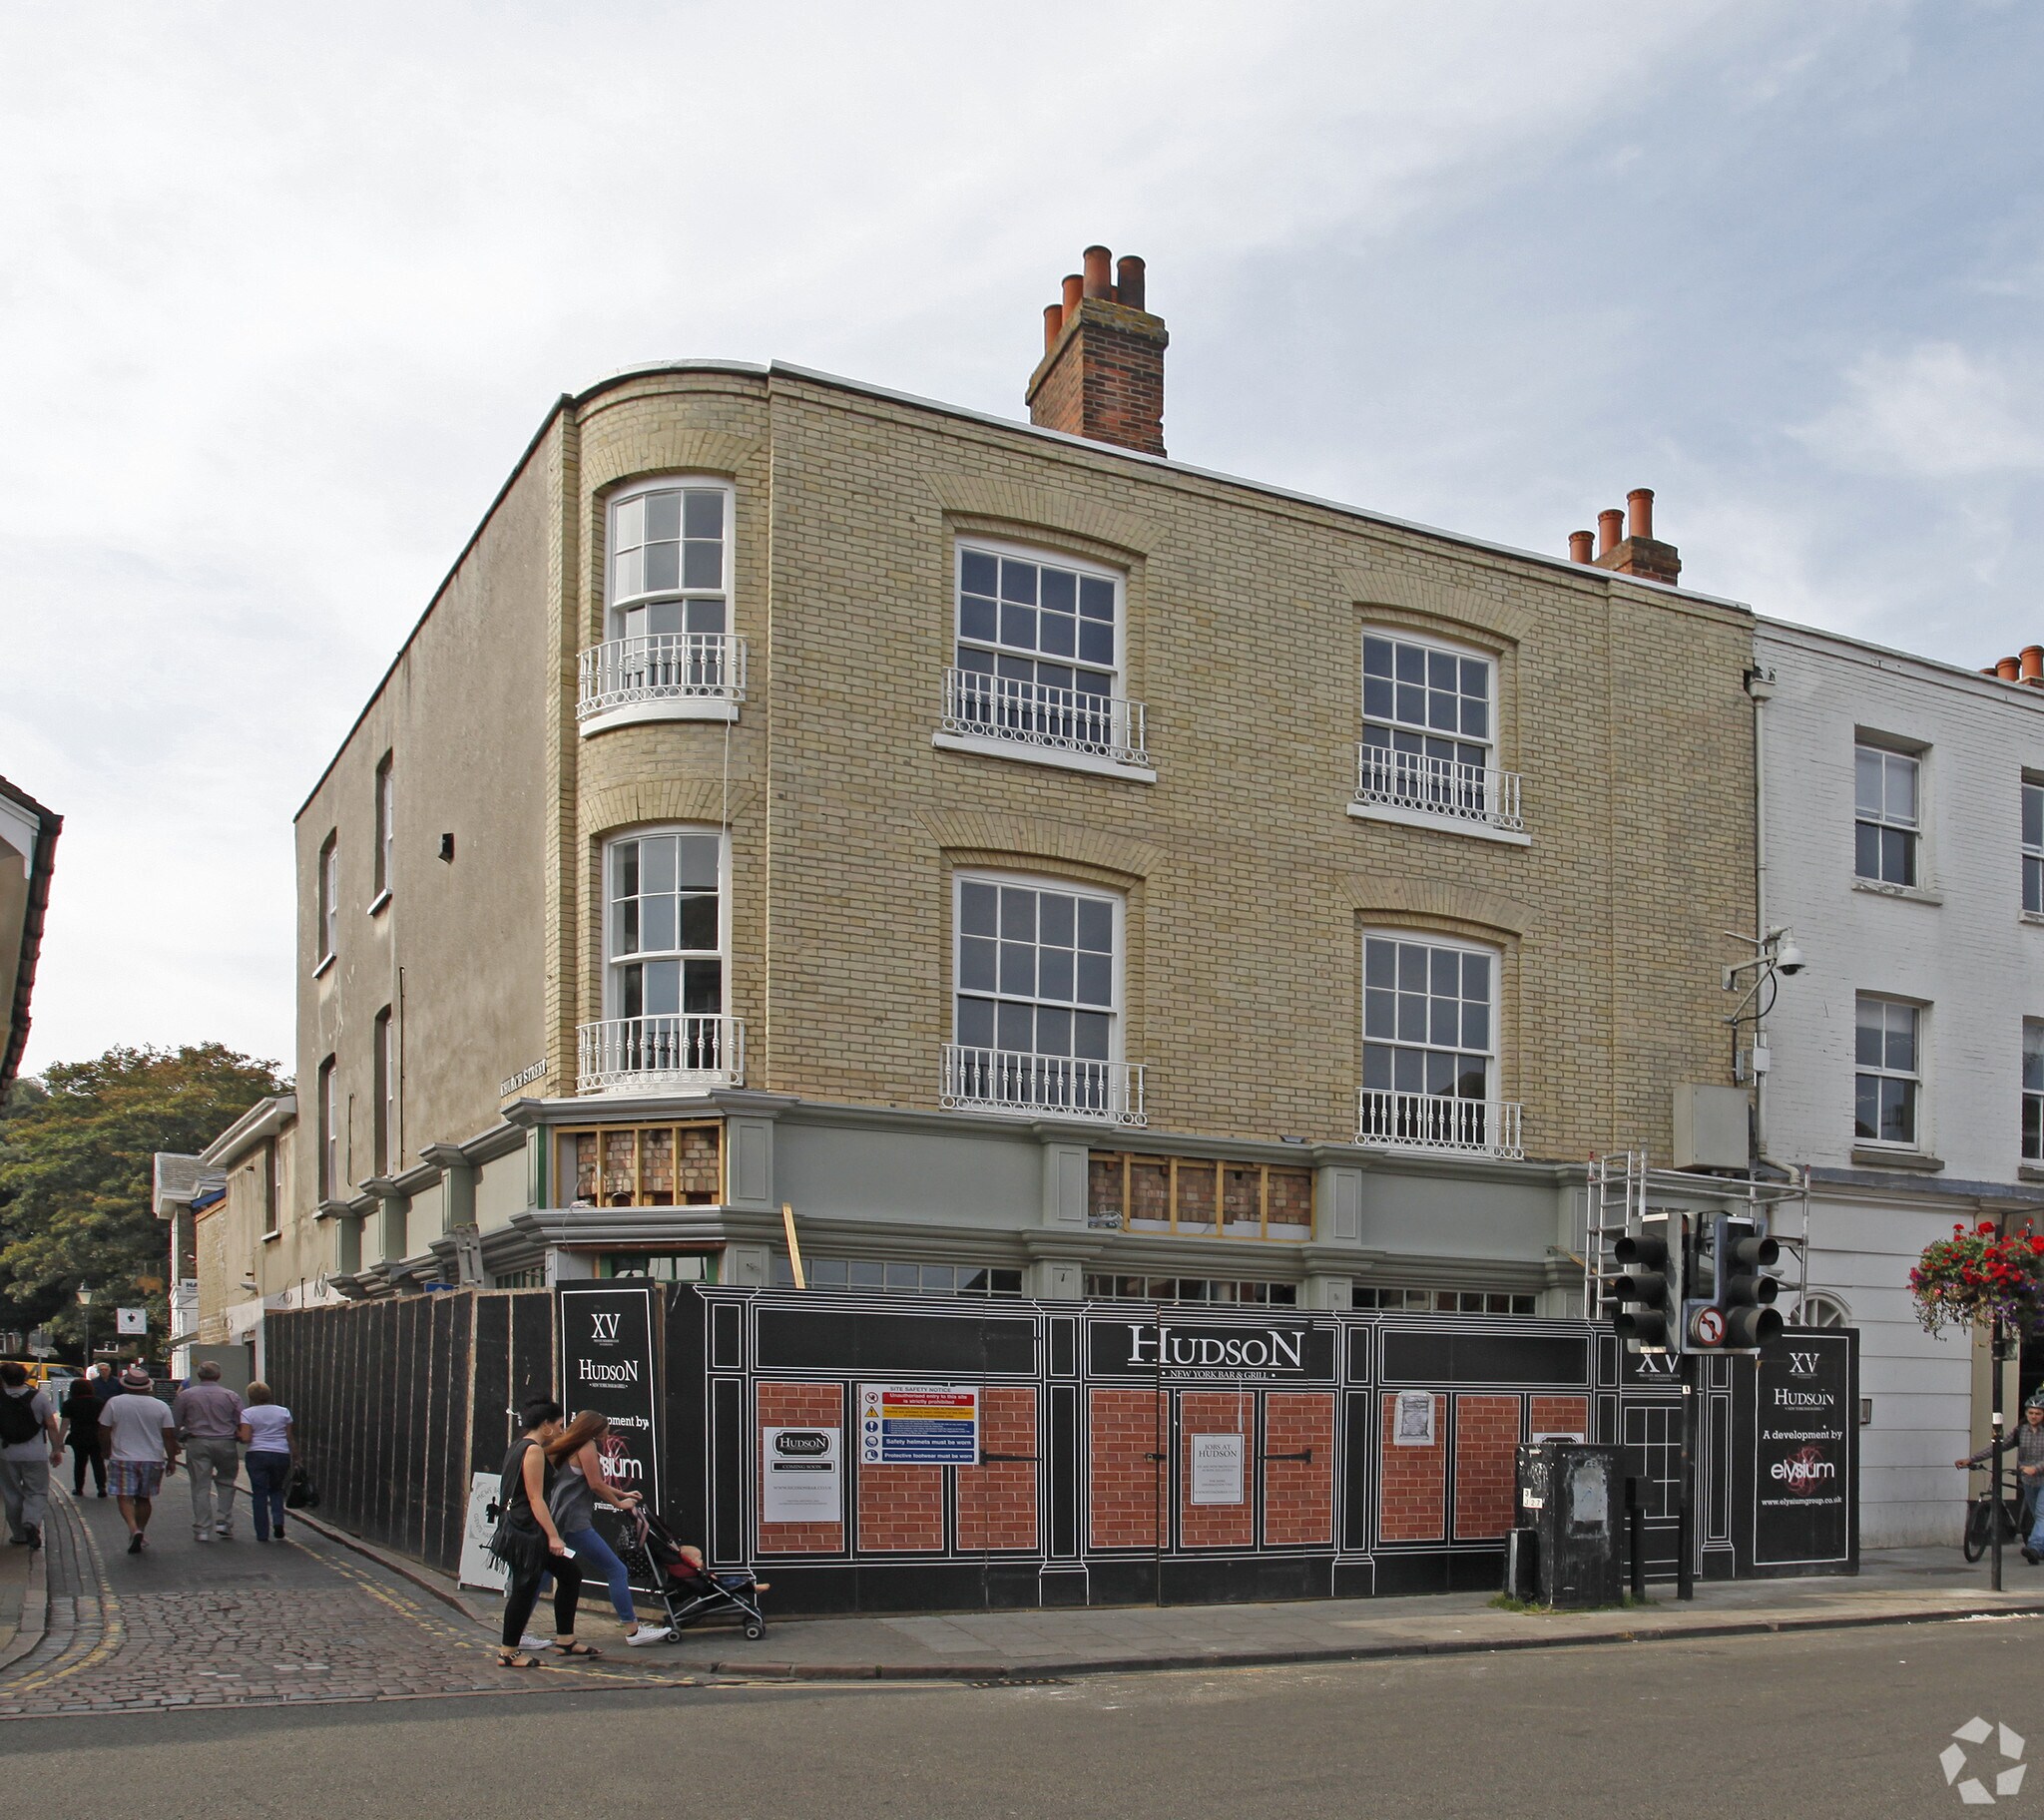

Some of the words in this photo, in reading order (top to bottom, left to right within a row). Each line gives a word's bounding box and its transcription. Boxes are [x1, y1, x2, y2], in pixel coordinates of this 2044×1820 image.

[523, 1059, 546, 1084] STREET
[591, 1313, 621, 1338] XV
[1789, 1353, 1820, 1373] XV
[1192, 1370, 1218, 1379] YORK
[1236, 1371, 1244, 1380] &
[1244, 1371, 1270, 1380] GRILL
[779, 1437, 826, 1447] HUDSON
[1763, 1430, 1771, 1439] A
[1772, 1430, 1829, 1441] development
[1830, 1430, 1842, 1441] by
[1771, 1459, 1834, 1483] elysium
[1762, 1496, 1842, 1506] www.elysiumgroup.co.uk
